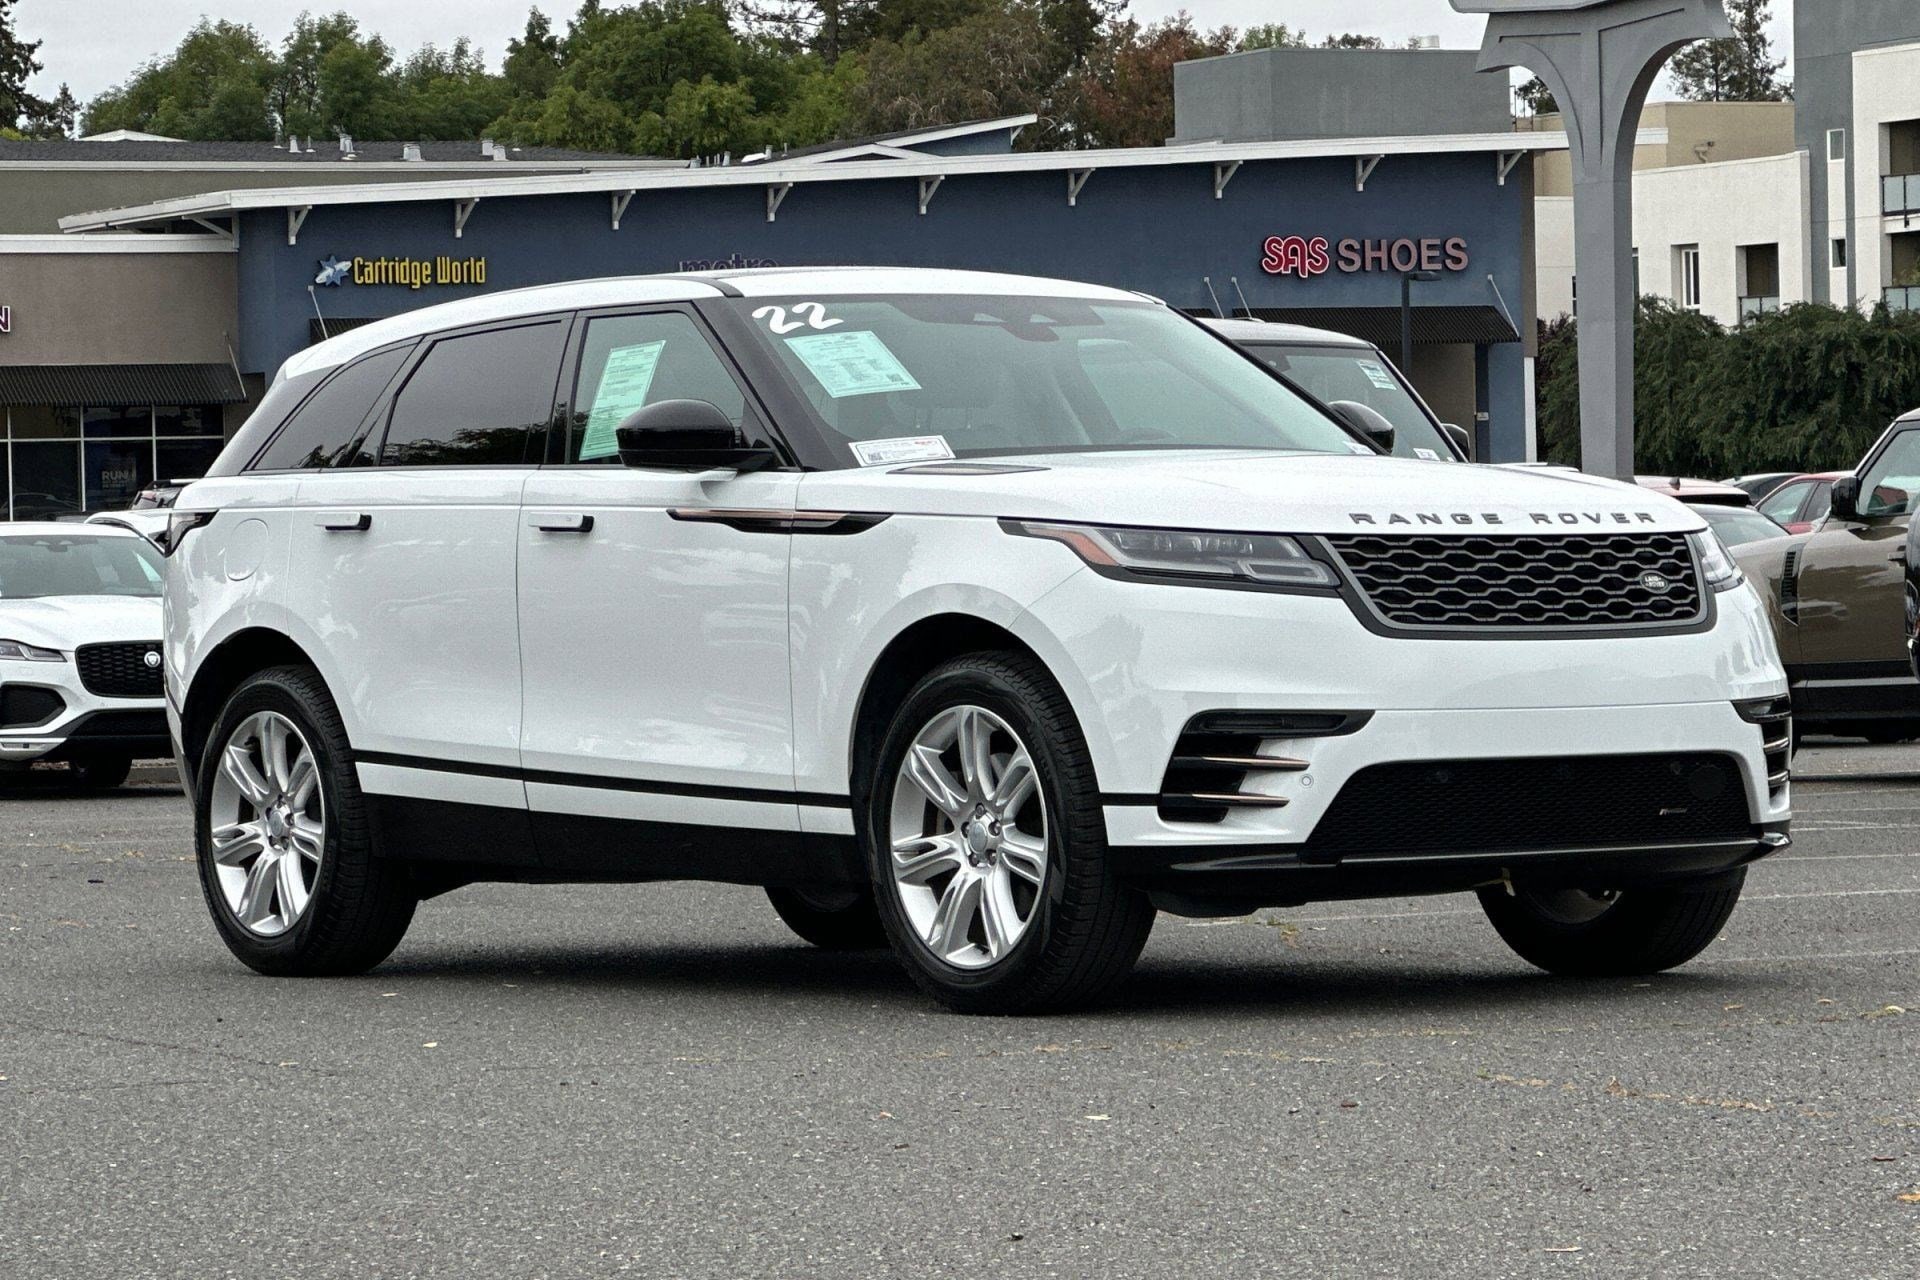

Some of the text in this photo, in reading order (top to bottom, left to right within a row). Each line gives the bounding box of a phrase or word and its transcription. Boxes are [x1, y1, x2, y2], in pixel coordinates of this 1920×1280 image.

[354, 256, 486, 289] Cartridge World
[1262, 236, 1469, 279] SAS SHOES
[751, 302, 845, 335] 22
[1349, 512, 1656, 525] RANGE ROVER
